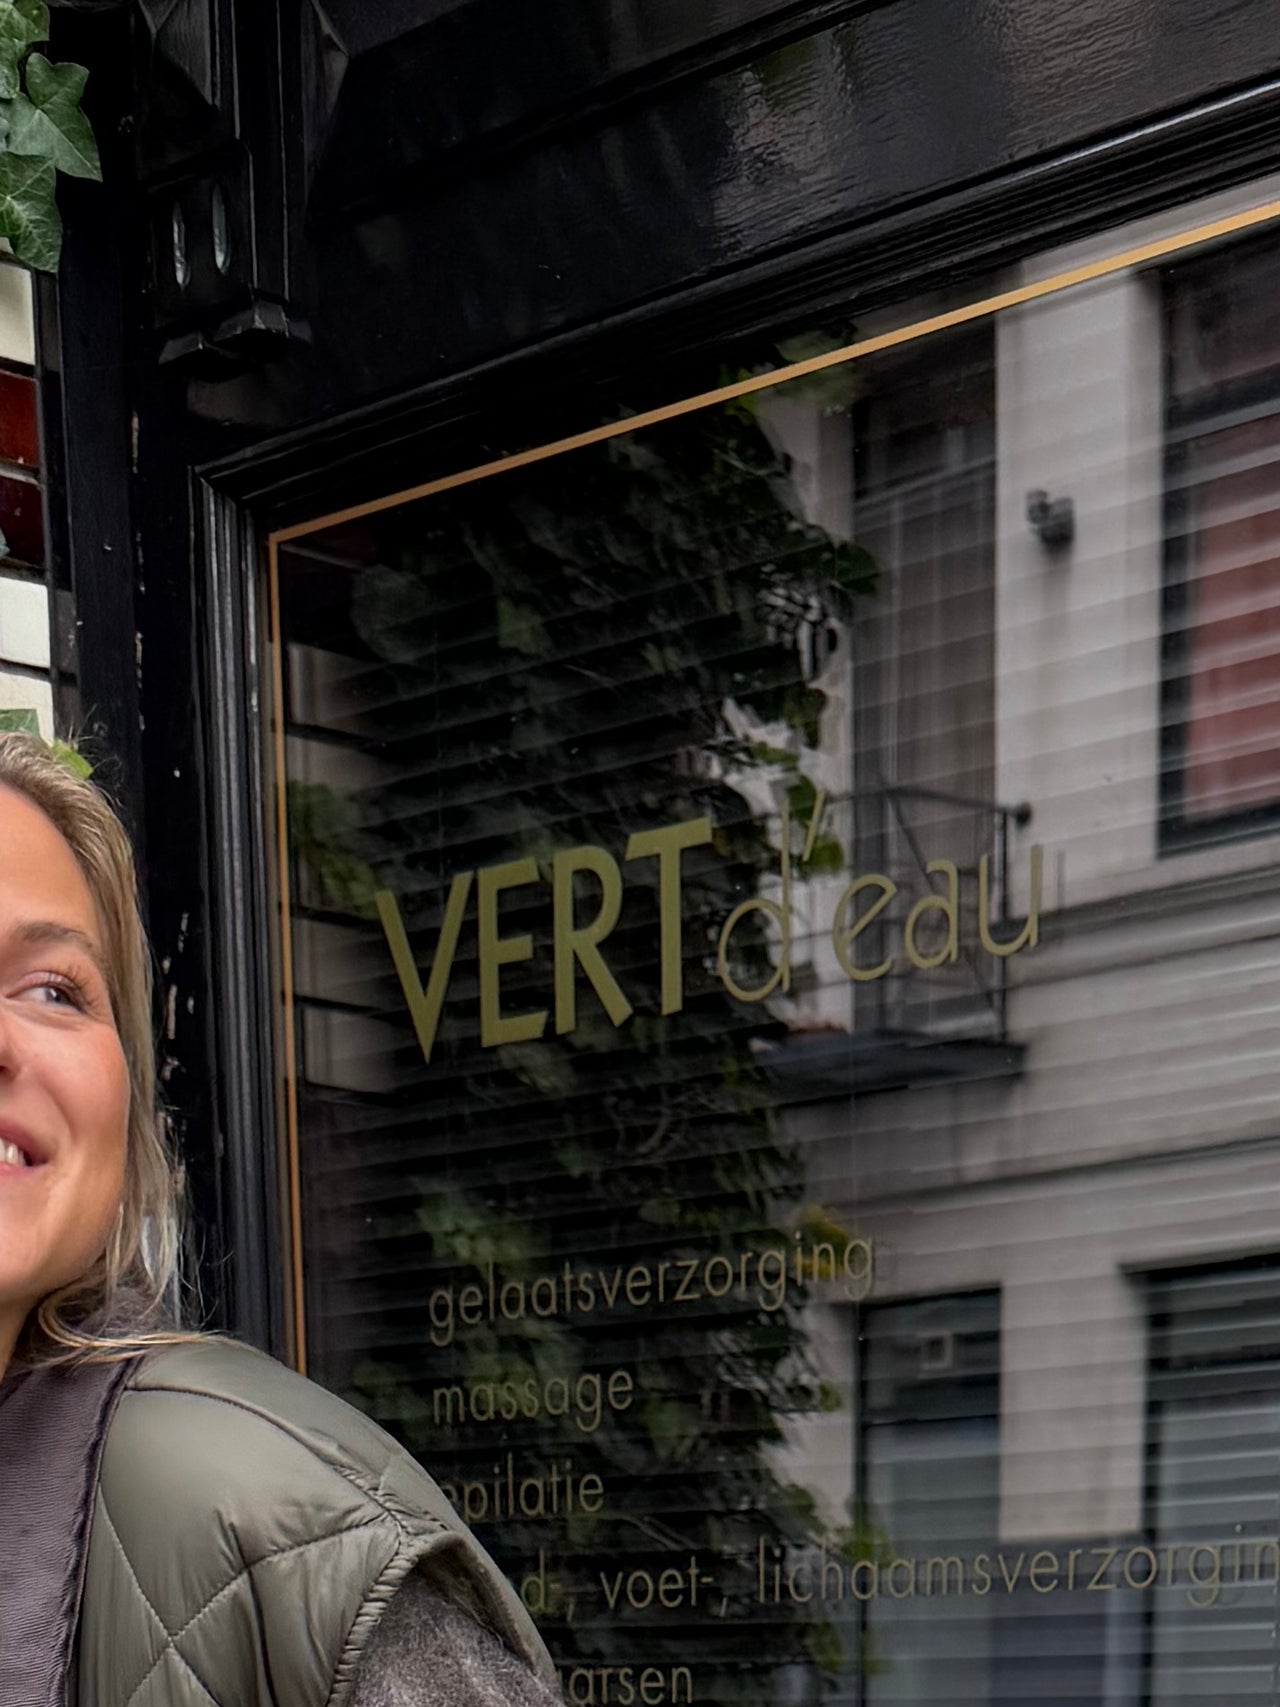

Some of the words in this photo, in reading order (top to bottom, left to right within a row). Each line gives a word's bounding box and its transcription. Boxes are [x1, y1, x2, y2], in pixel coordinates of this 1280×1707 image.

[375, 817, 712, 1064] VERT
[719, 790, 1045, 1003] d'eau
[428, 1231, 874, 1347] gelaatsverzorging
[433, 1369, 634, 1432] massage
[557, 1665, 693, 1706] arsen
